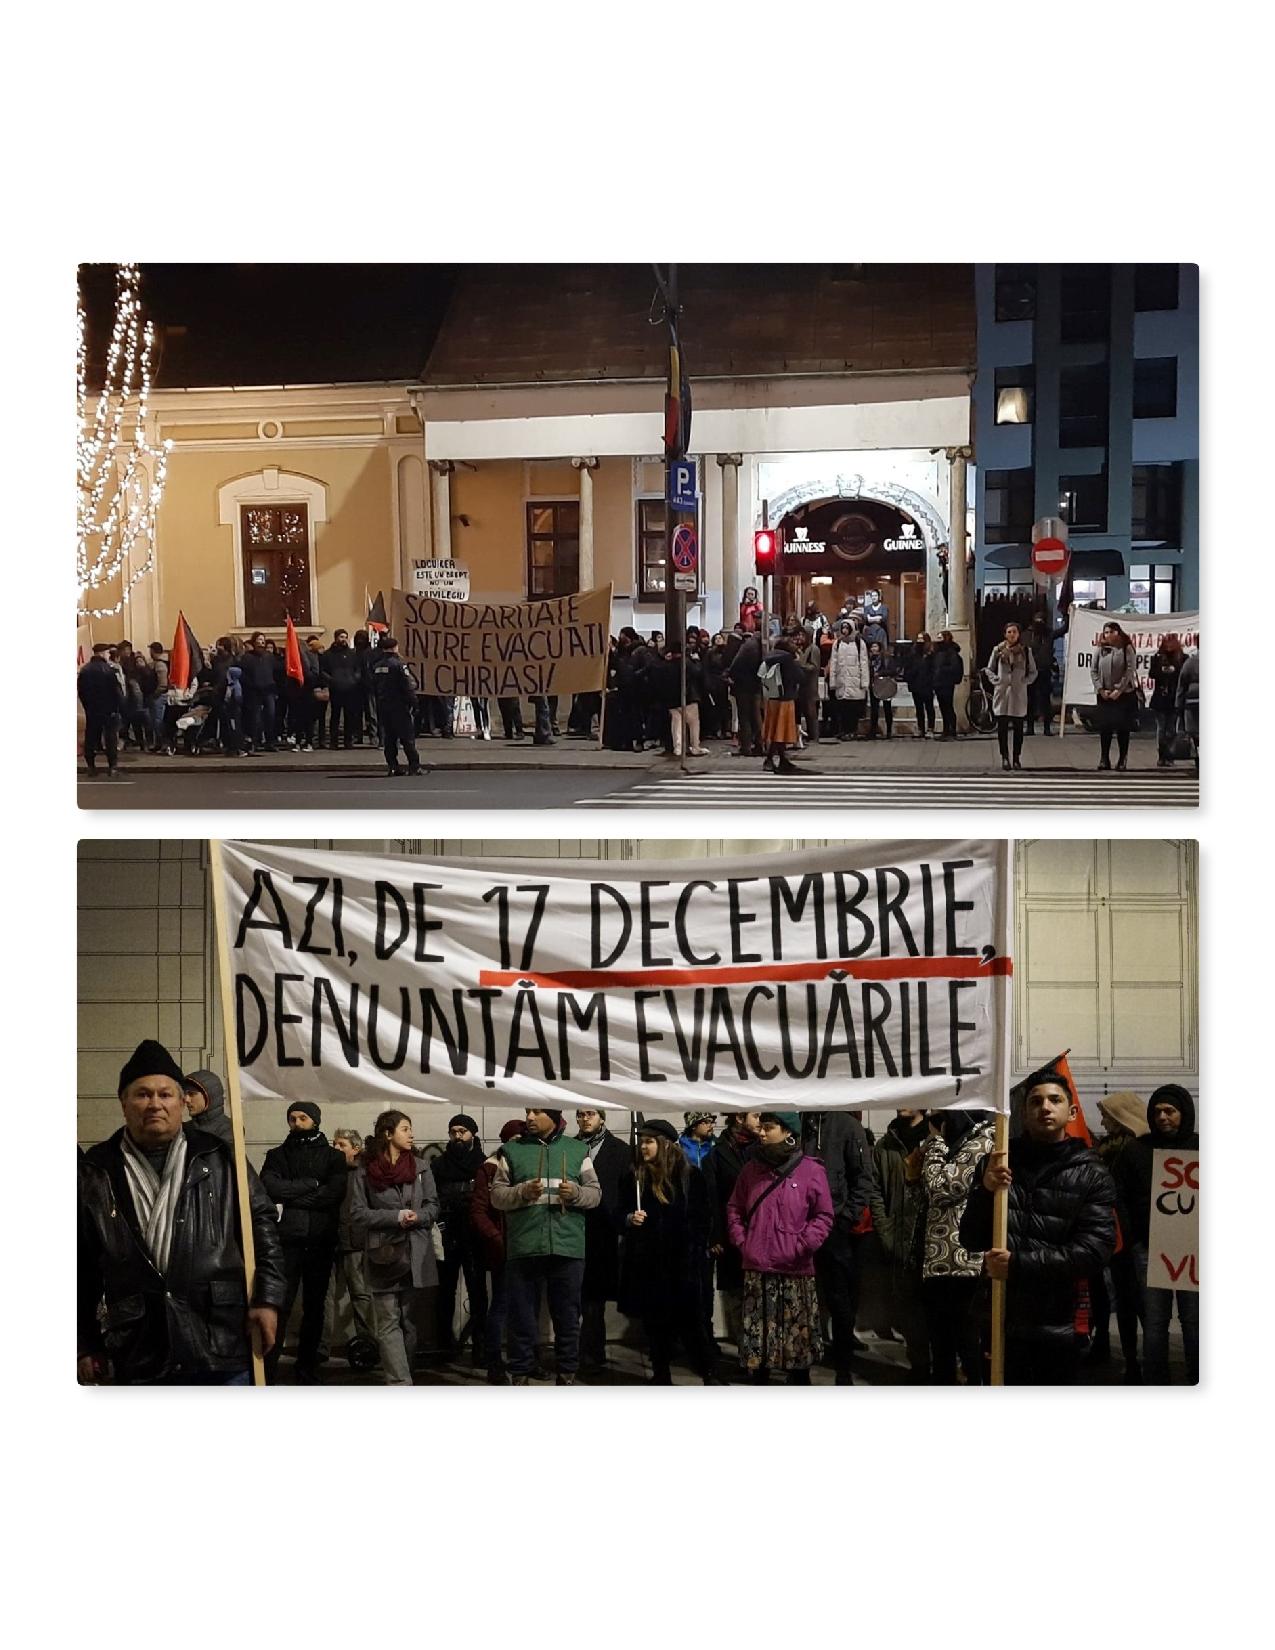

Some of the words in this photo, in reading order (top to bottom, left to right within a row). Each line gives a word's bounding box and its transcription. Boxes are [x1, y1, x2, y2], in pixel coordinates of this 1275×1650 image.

[677, 467, 690, 496] P
[883, 538, 924, 551] GUINNE
[405, 594, 580, 630] SOLIDARITATE
[234, 868, 358, 967] AZI,
[375, 880, 445, 962] DE
[481, 884, 550, 970] 17
[590, 860, 997, 970] DECEMBRIE,
[1156, 1191, 1195, 1215] CU
